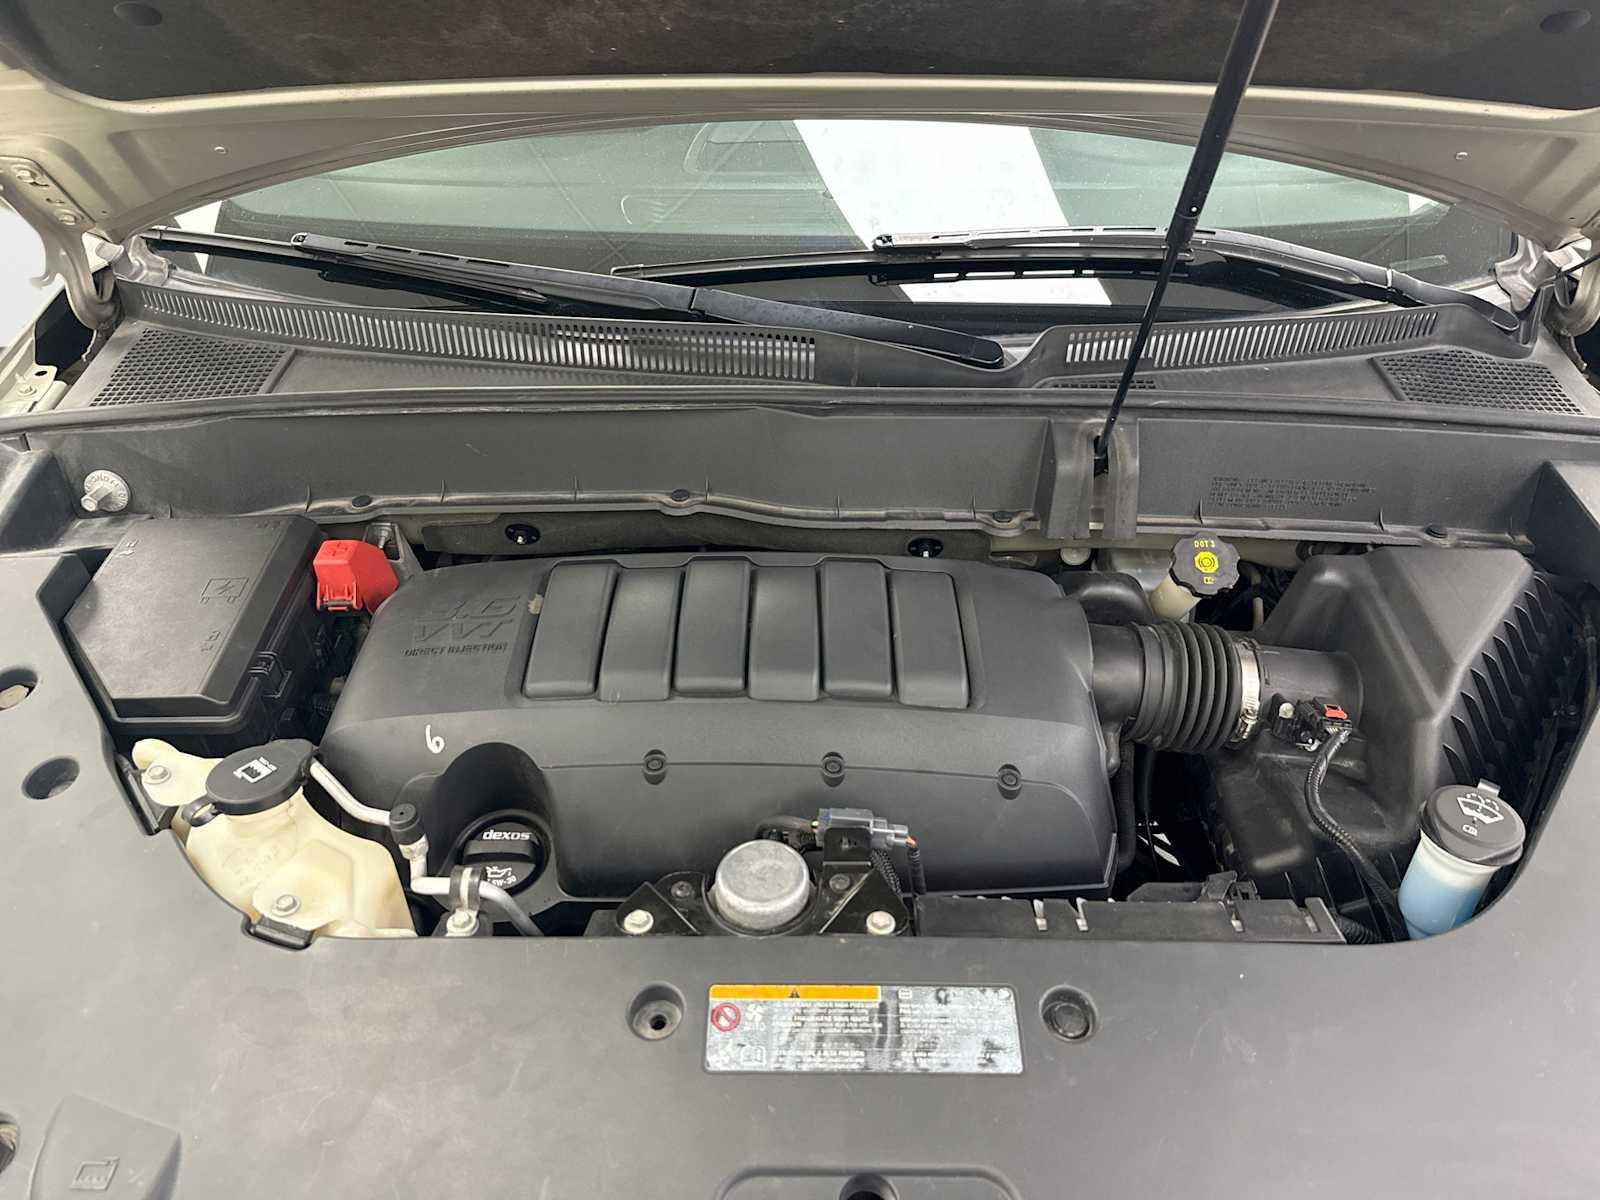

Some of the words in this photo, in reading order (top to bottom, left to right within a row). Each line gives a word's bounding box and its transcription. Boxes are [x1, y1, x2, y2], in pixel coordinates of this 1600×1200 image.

[1193, 539, 1209, 549] DOT
[402, 645, 446, 657] DIRECT
[447, 642, 509, 654] INJECTION
[425, 724, 445, 754] 6
[482, 829, 532, 841] dexos
